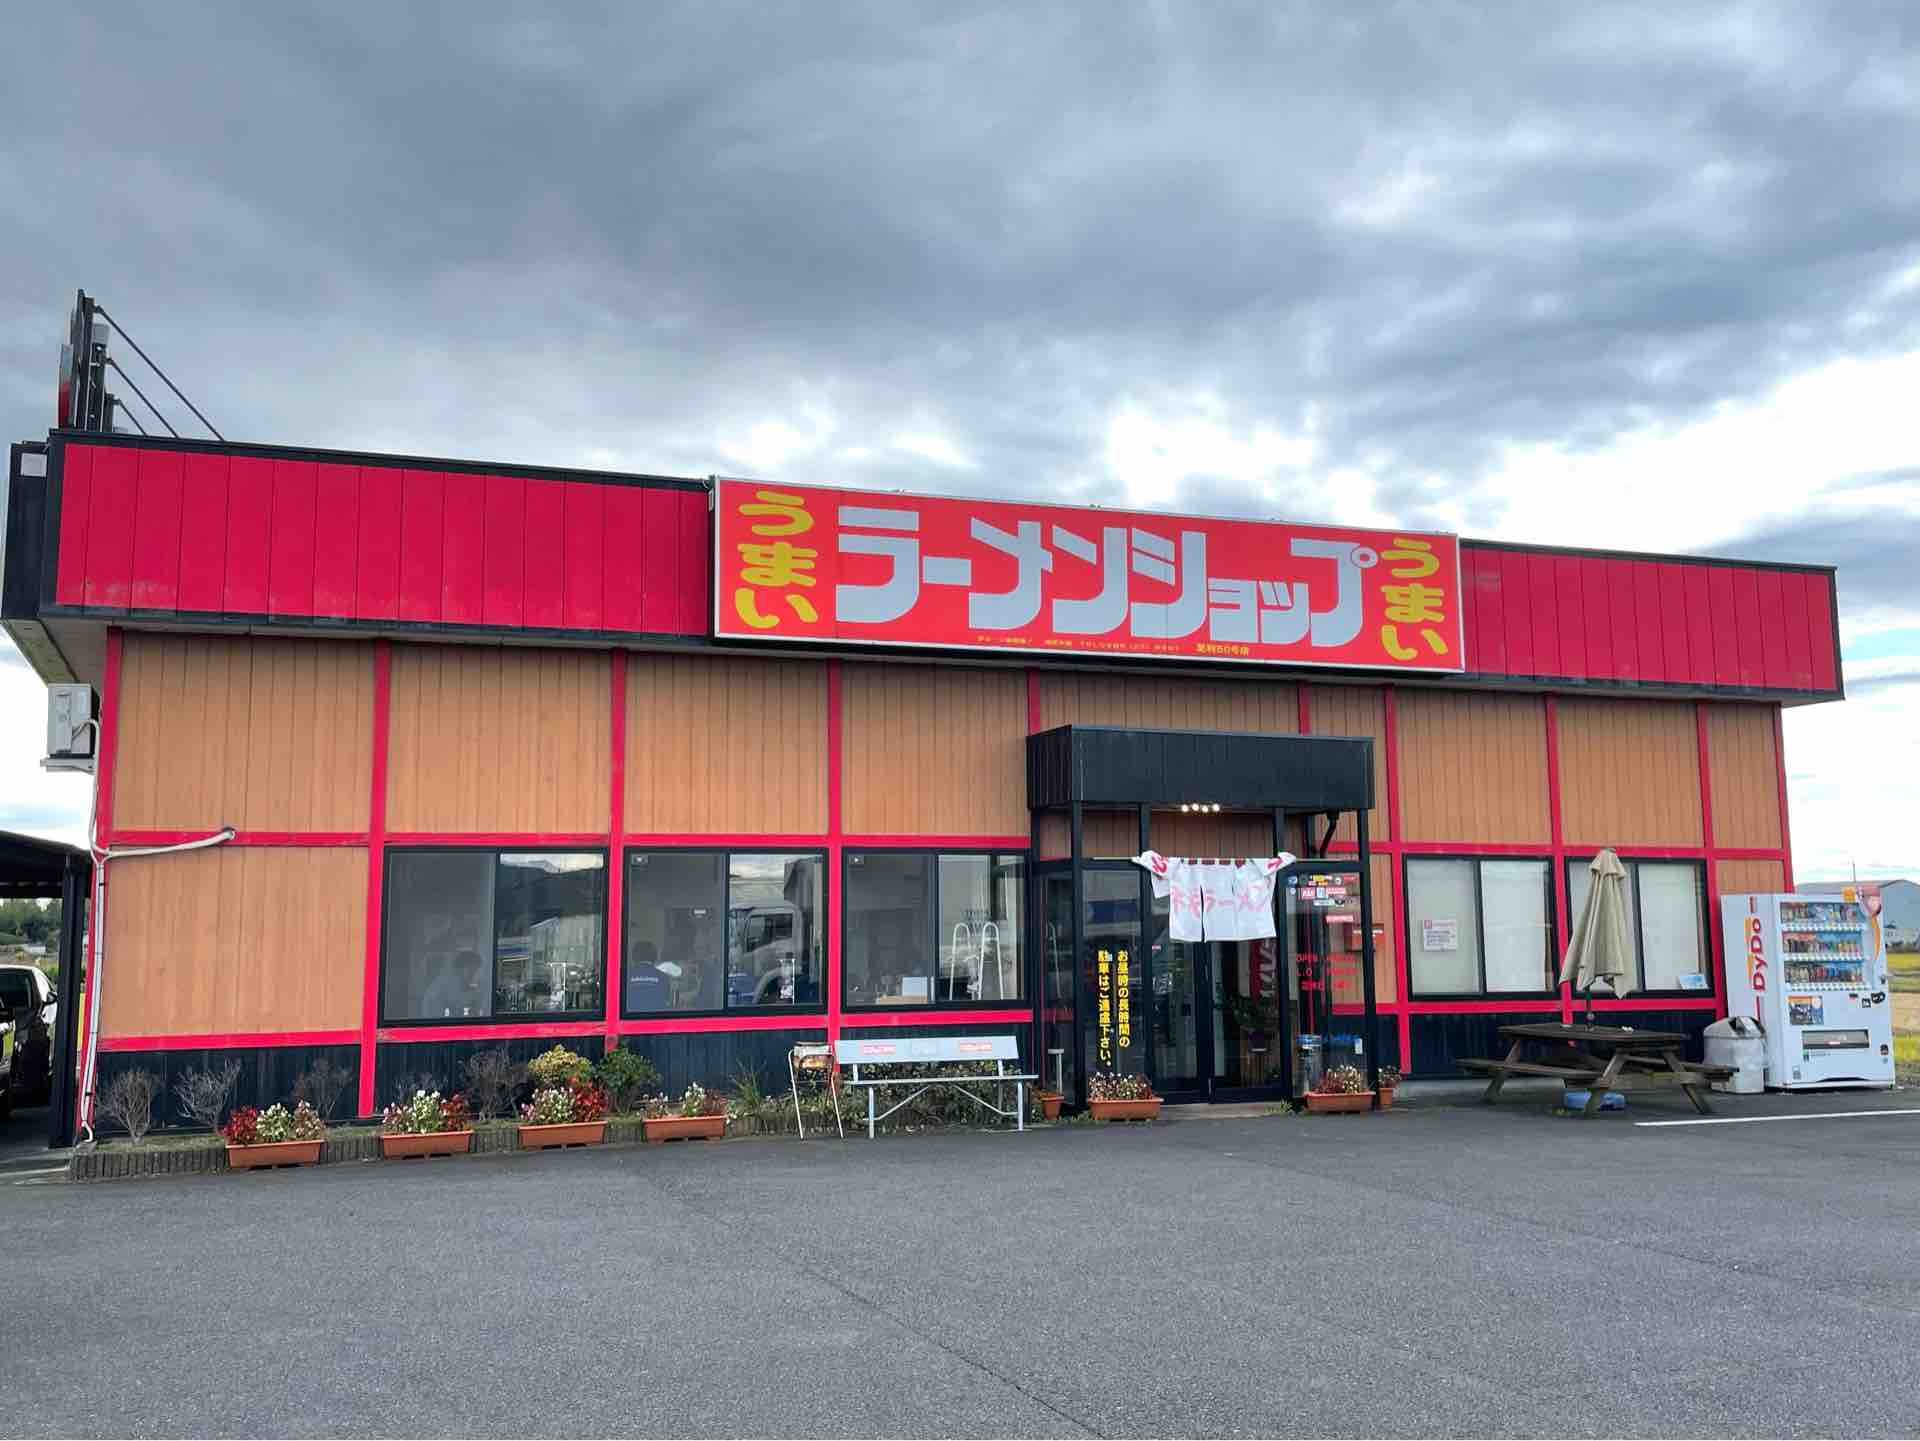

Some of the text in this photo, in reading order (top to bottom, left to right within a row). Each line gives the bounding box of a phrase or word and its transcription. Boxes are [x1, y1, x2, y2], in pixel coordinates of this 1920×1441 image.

[736, 490, 819, 629] うまい
[835, 505, 1380, 648] ラーメンショップ
[1380, 537, 1449, 661] うまい
[1751, 918, 1768, 991] DyDo
